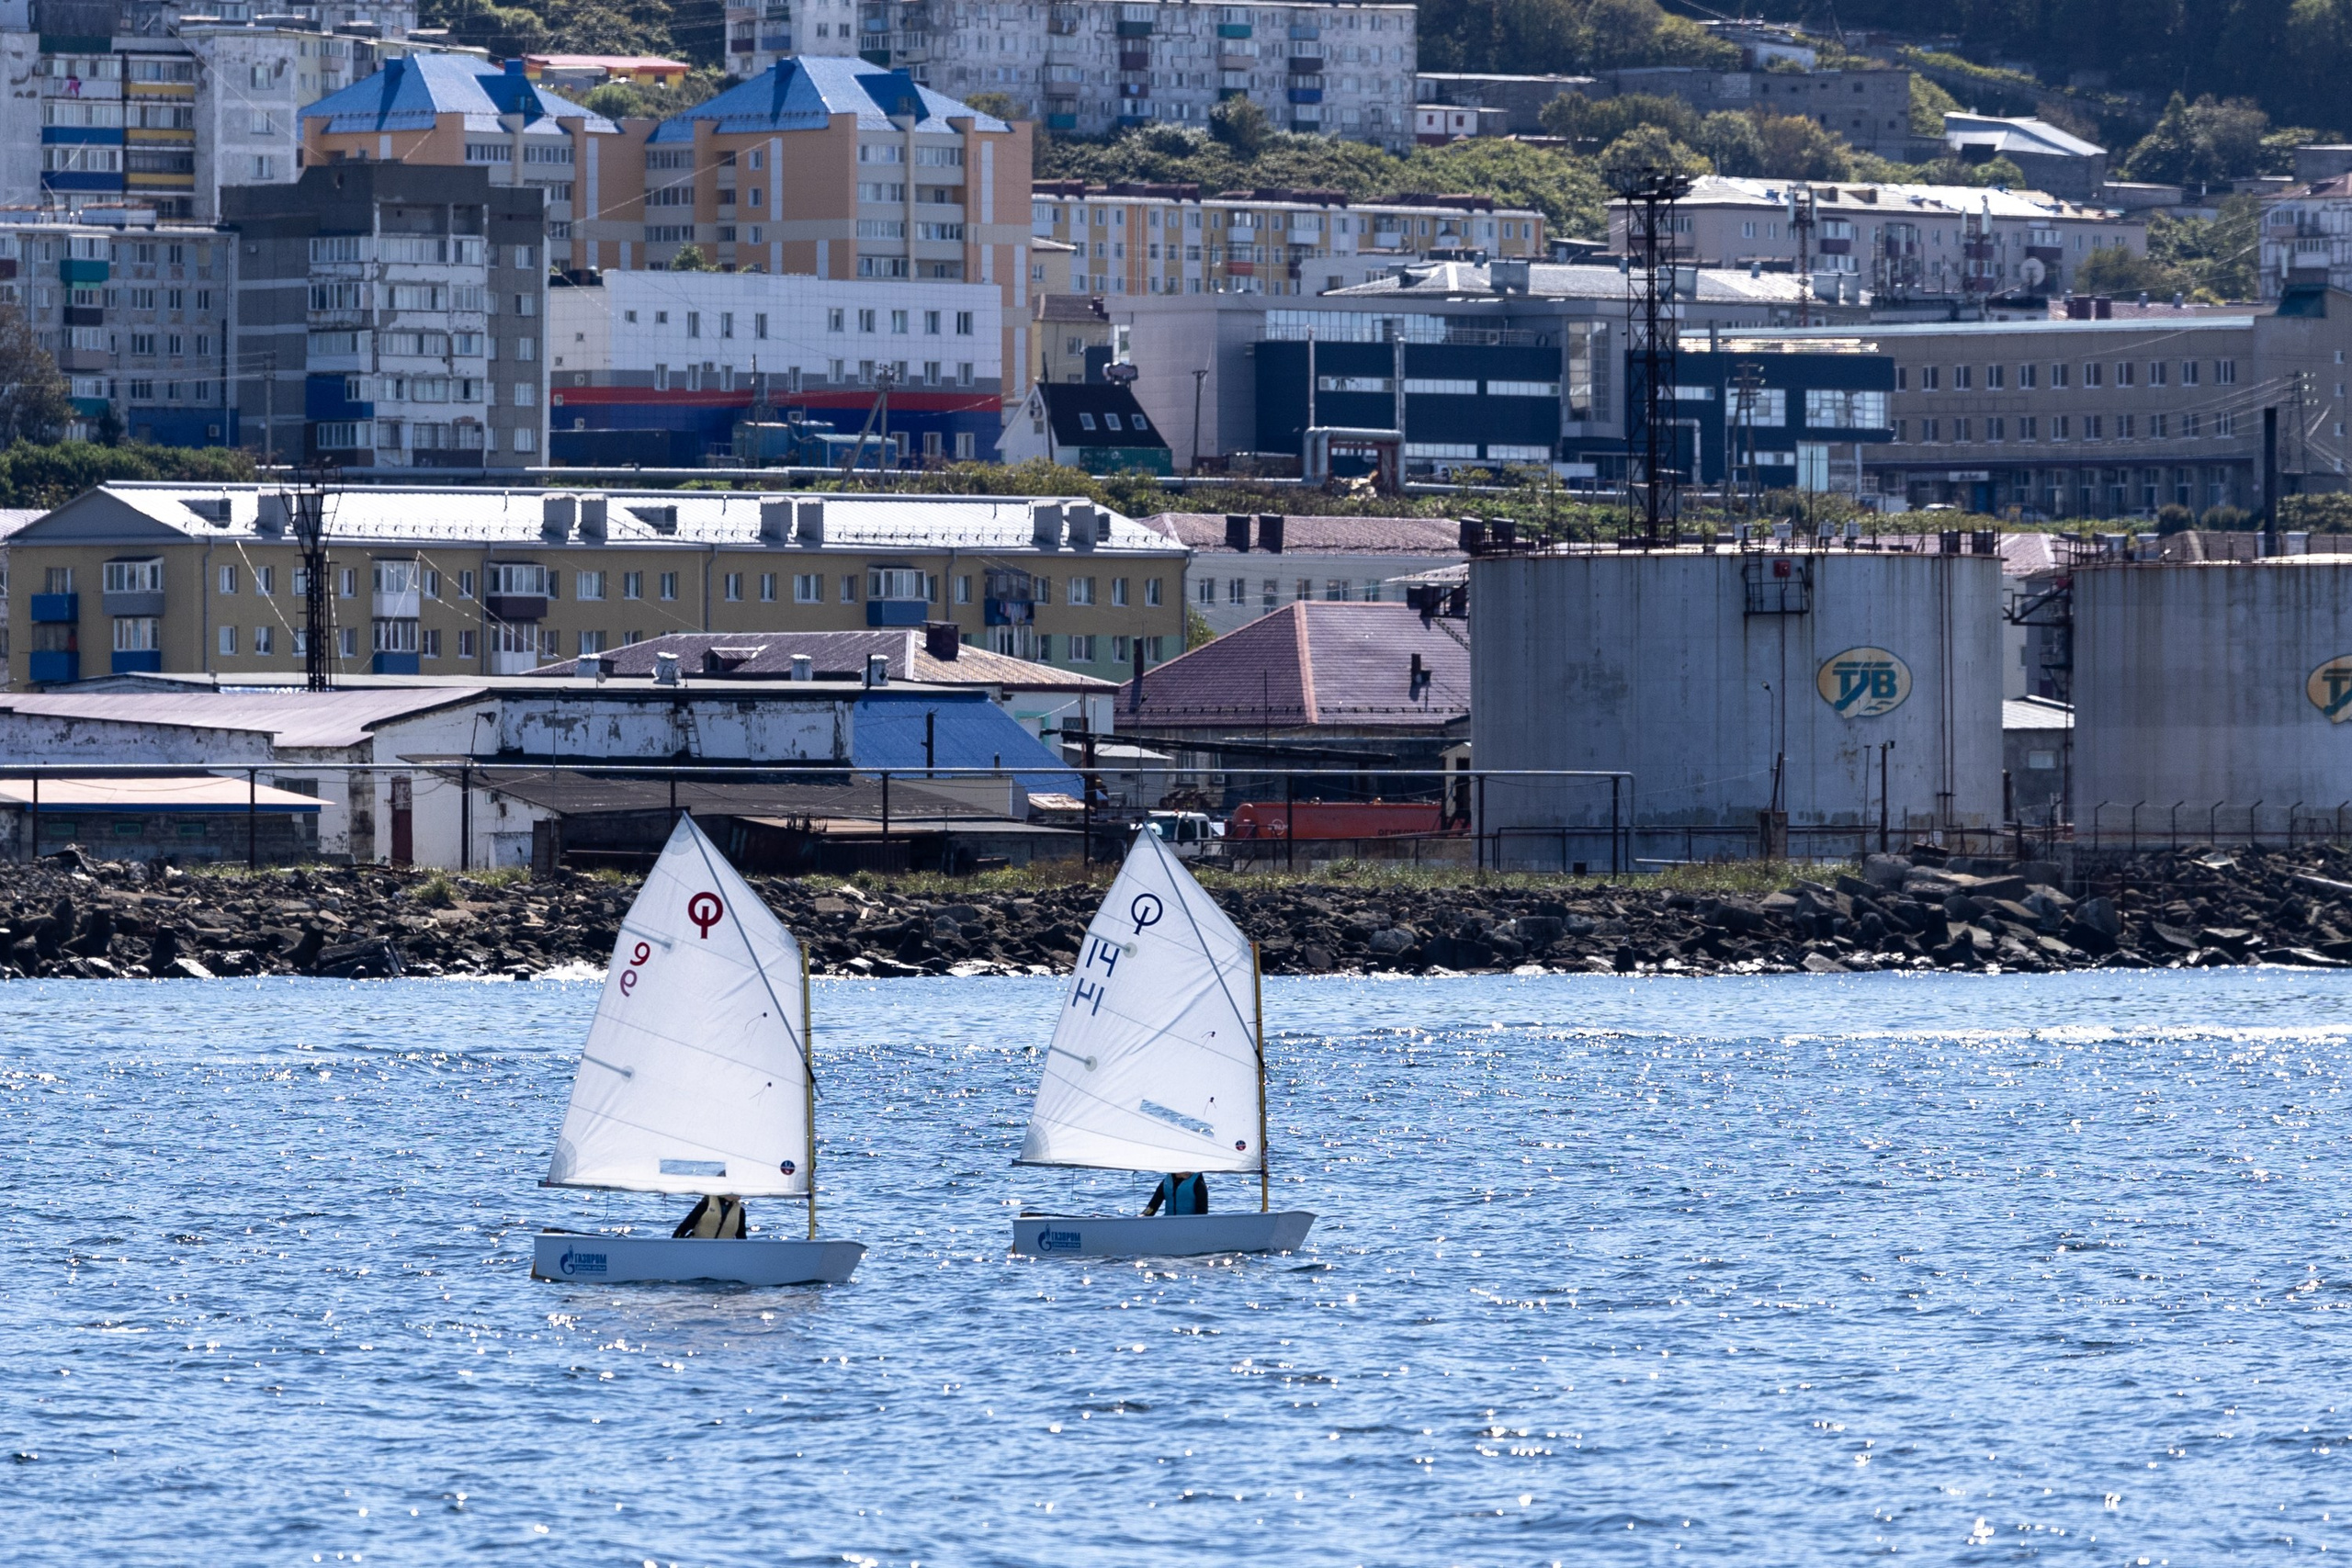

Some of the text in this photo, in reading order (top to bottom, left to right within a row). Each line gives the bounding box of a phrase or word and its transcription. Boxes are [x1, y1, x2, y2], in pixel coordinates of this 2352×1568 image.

[629, 942, 651, 966] 9
[1085, 938, 1120, 978] 14
[574, 1253, 607, 1265] ГАЗПРОМ
